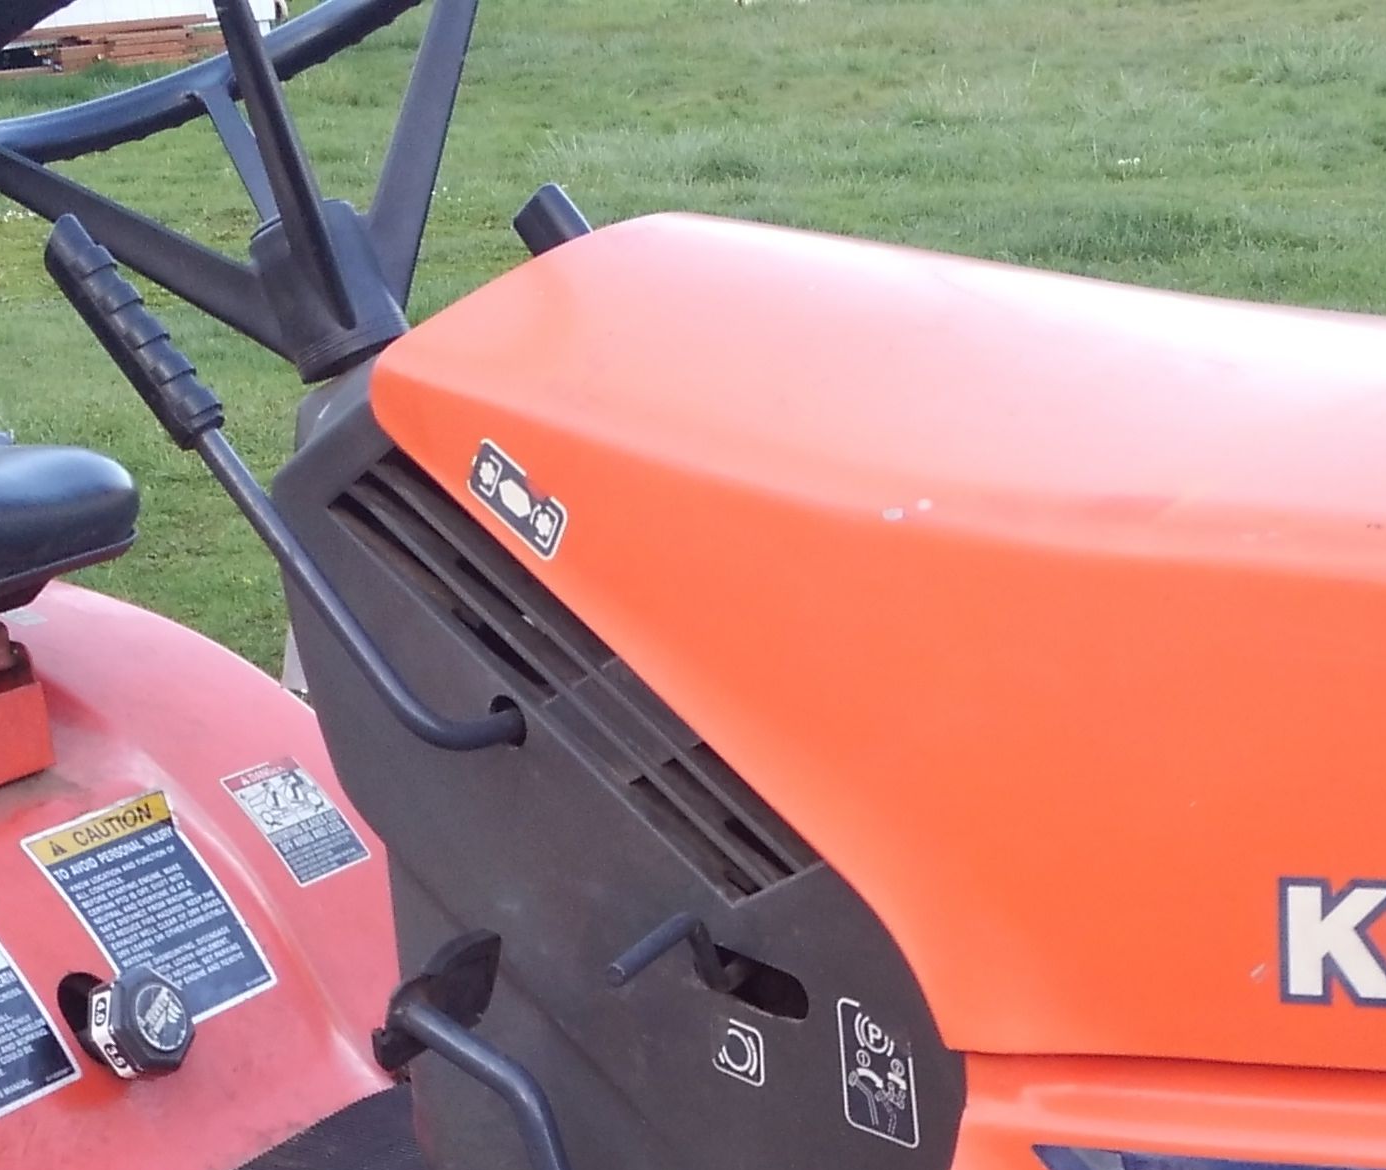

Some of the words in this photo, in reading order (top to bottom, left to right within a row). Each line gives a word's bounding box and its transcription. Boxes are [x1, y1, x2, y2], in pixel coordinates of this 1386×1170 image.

[71, 804, 153, 847] CAUTION
[53, 867, 70, 881] TO
[68, 856, 98, 875] AVOID
[96, 838, 144, 864] PERSONAL
[141, 825, 174, 846] INJURY
[89, 867, 121, 884] LOCATION
[121, 861, 136, 871] AND
[135, 848, 166, 865] FUNCTION
